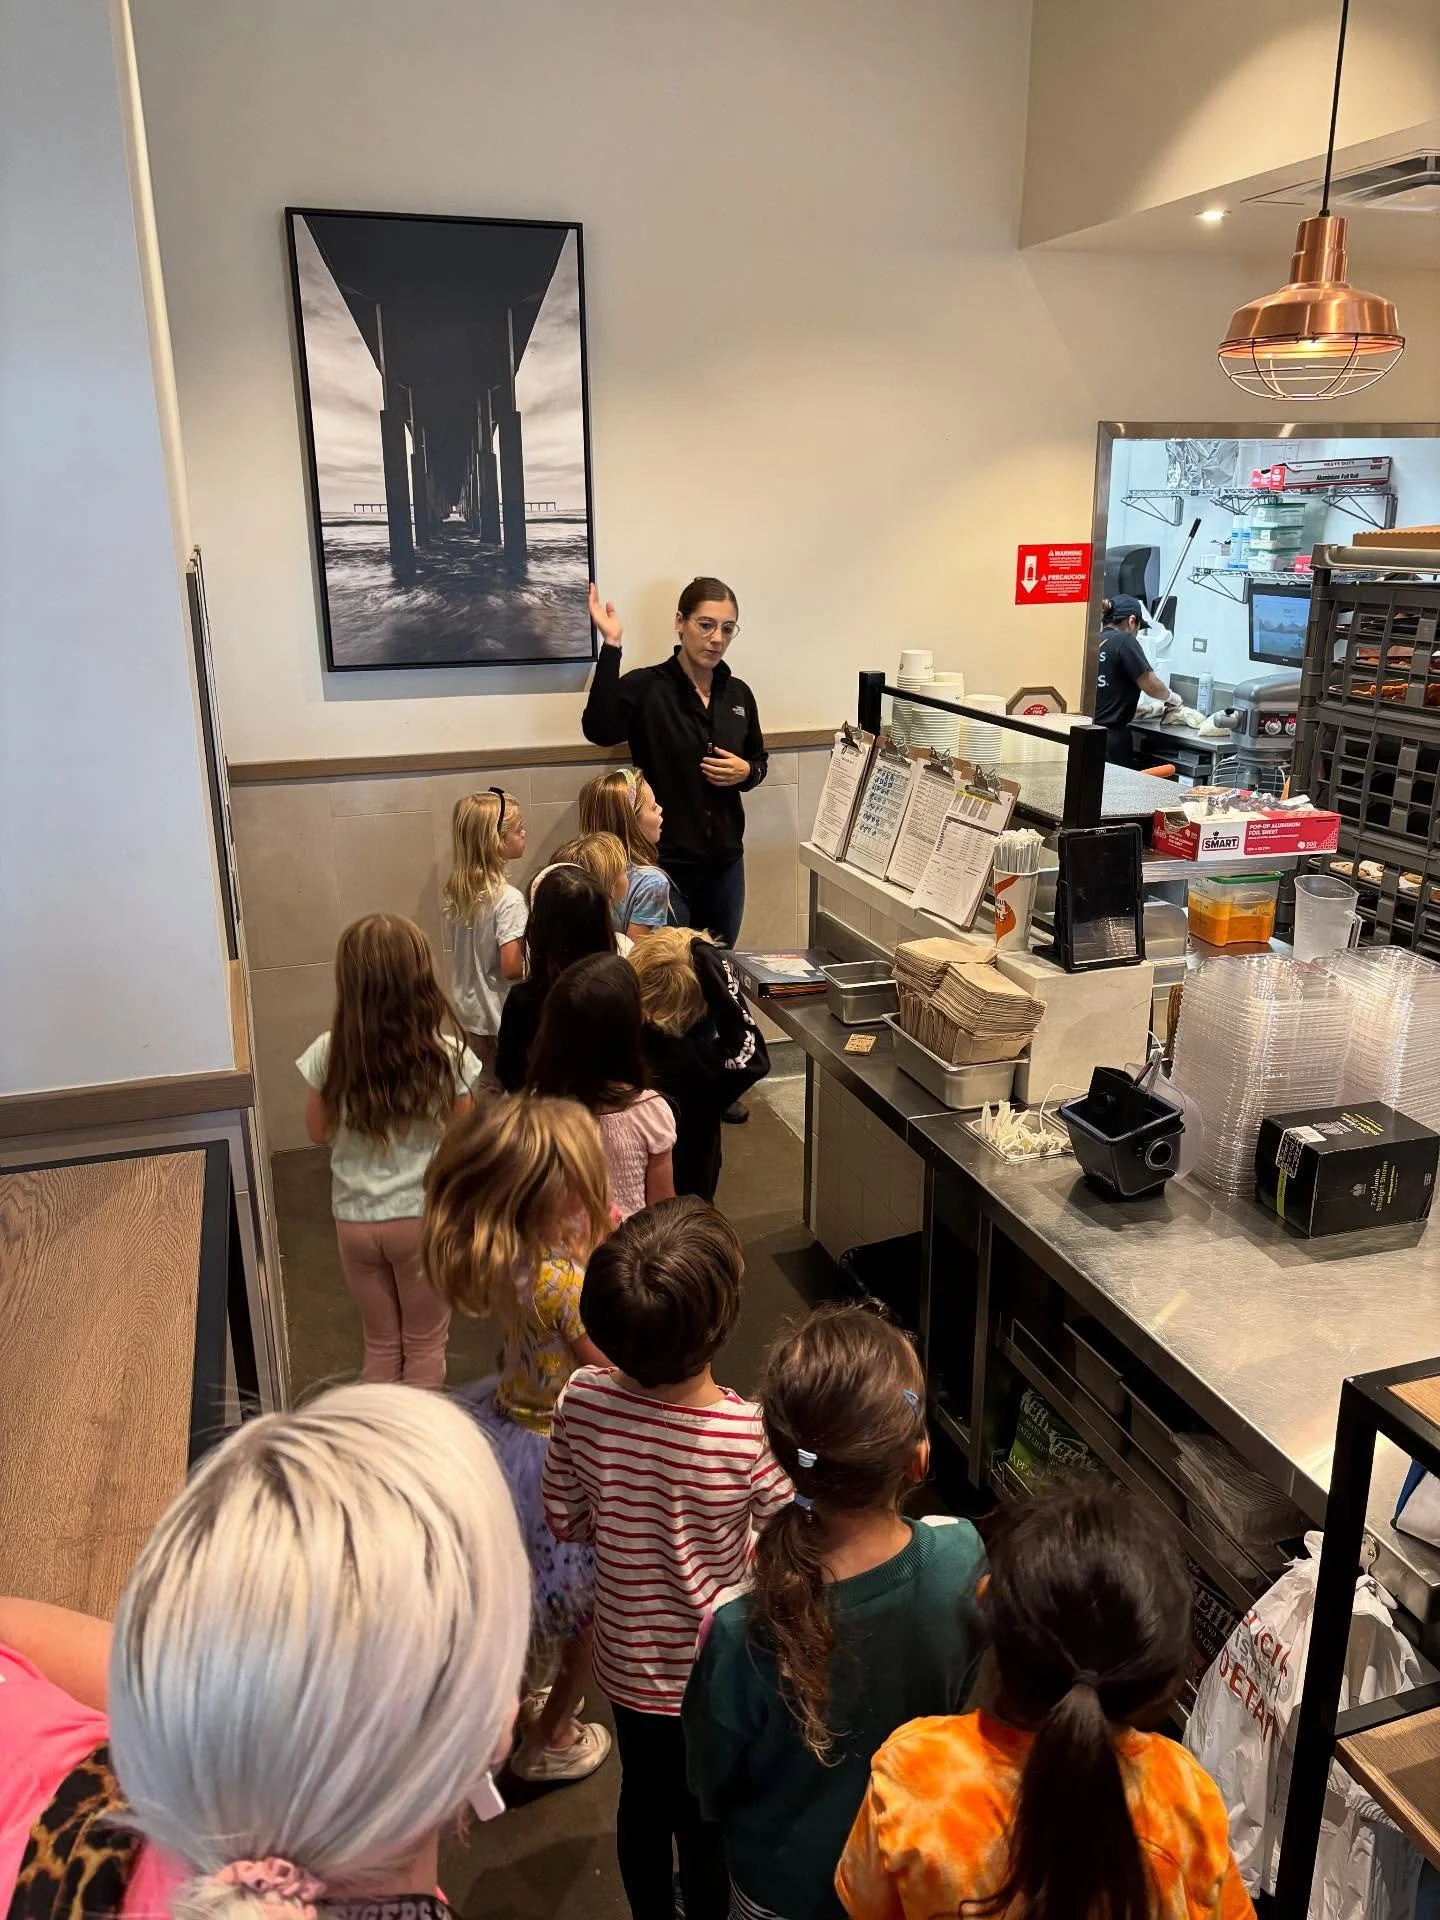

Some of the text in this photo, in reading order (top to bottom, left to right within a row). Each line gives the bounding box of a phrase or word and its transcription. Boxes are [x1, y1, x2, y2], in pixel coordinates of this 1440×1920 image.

[1099, 651, 1106, 661] S
[1097, 675, 1109, 687] S.
[1271, 821, 1301, 829] ALUMINUM
[1205, 838, 1237, 849] SMART
